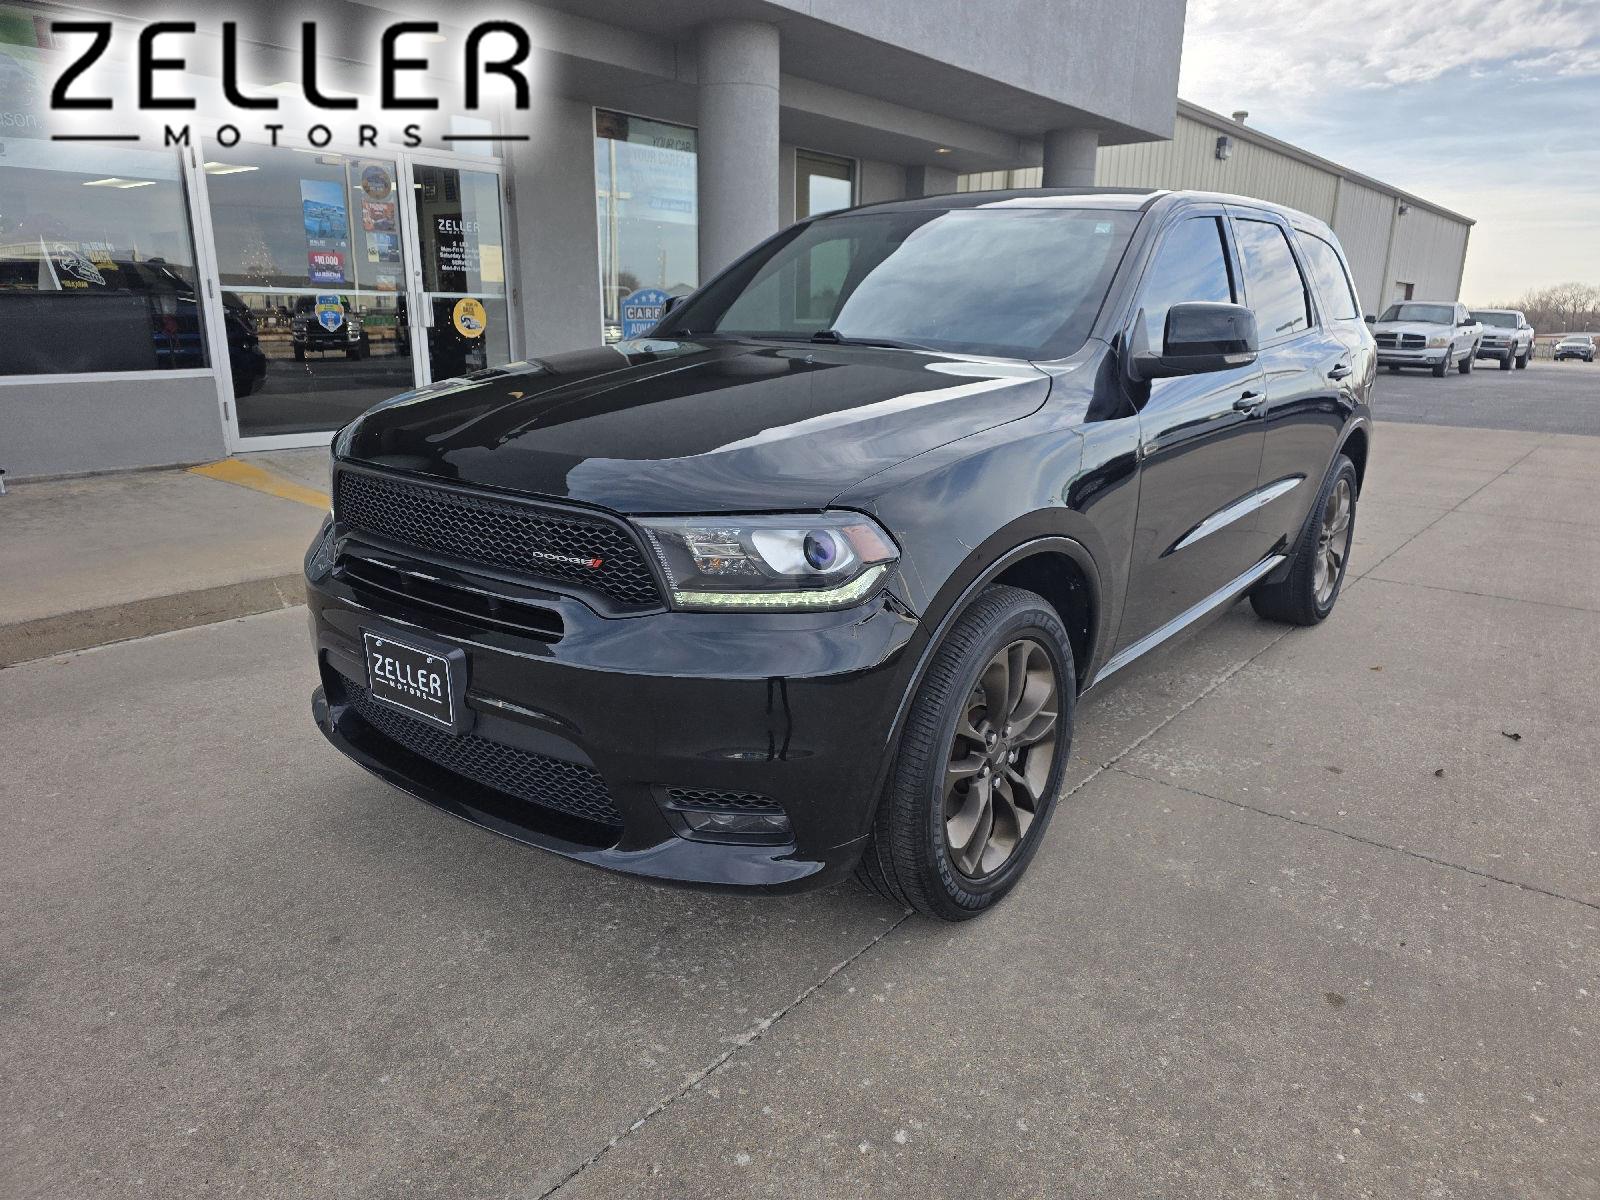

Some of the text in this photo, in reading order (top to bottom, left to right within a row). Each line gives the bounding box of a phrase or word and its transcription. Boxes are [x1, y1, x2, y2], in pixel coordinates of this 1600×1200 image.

[438, 218, 480, 232] ZELLER
[532, 551, 593, 567] DODGE
[372, 652, 442, 697] ZELLER
[389, 680, 427, 700] MOTORS
